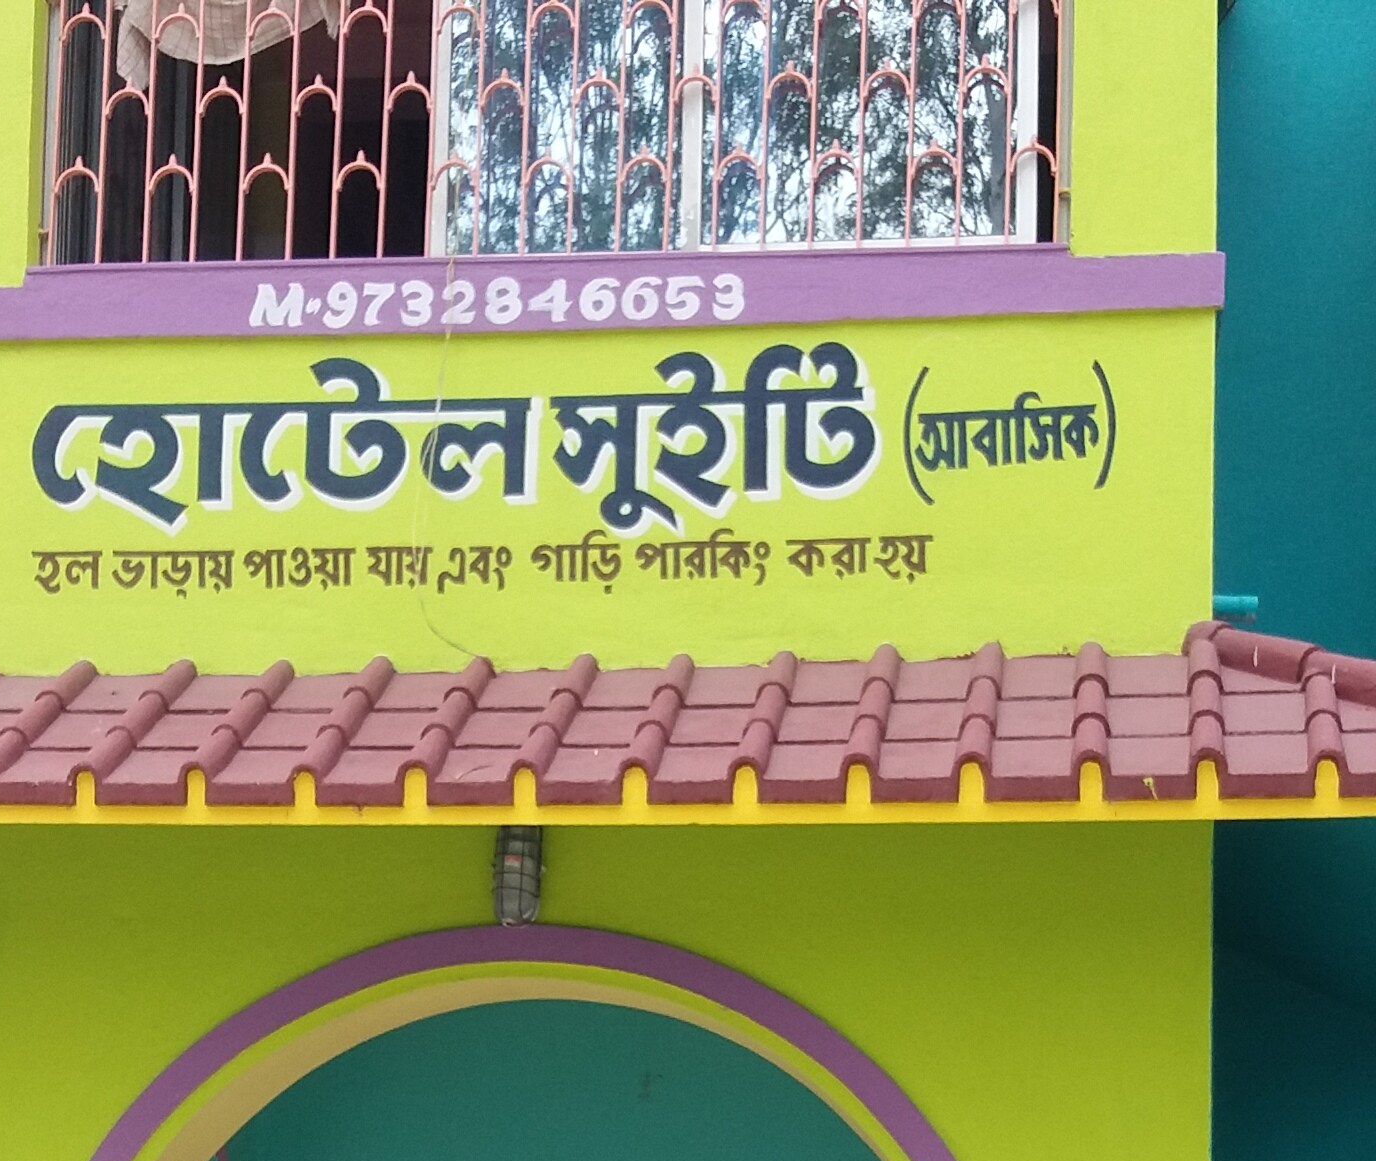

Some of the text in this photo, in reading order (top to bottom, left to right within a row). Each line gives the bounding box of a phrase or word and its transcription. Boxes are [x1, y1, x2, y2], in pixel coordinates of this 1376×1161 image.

[32, 341, 1117, 534] হোটেল সুইটি (আবাসিক)
[32, 527, 934, 598] হল ভাড়ায় পাওয়া যায় এবং গাড়ি পারকিং করা হয়
